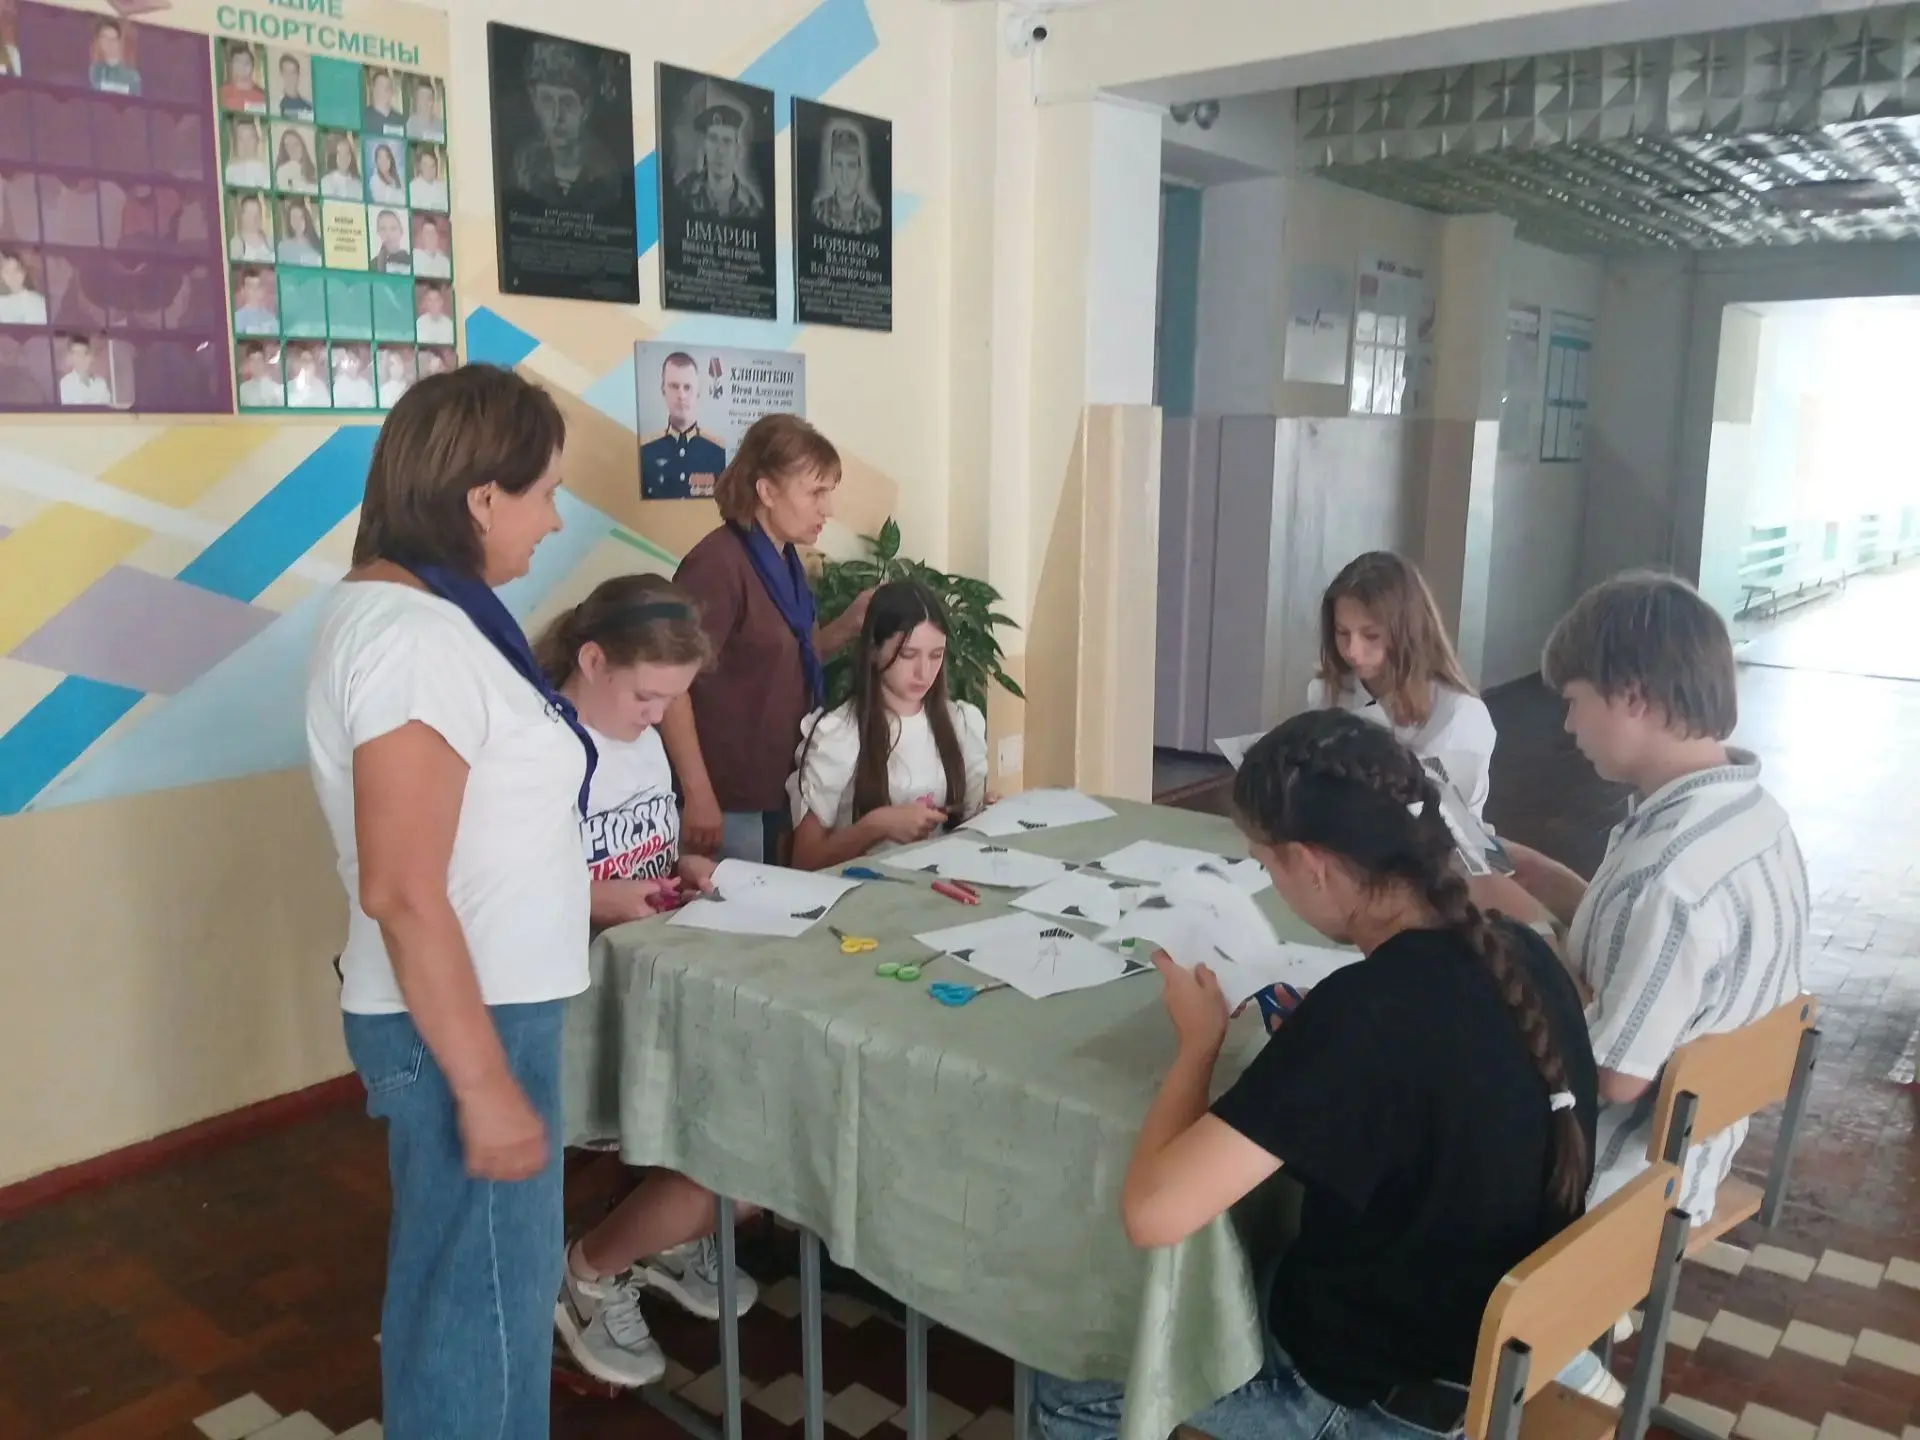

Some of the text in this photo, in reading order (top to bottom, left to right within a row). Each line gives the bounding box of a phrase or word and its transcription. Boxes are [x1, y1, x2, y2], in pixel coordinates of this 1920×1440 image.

[268, 0, 343, 19] ШИЕ
[215, 4, 419, 65] СПОРТСМЕНЫ
[812, 233, 880, 259] НОВИКОВ
[810, 260, 883, 283] ВЛАДИМИРОВИЧ
